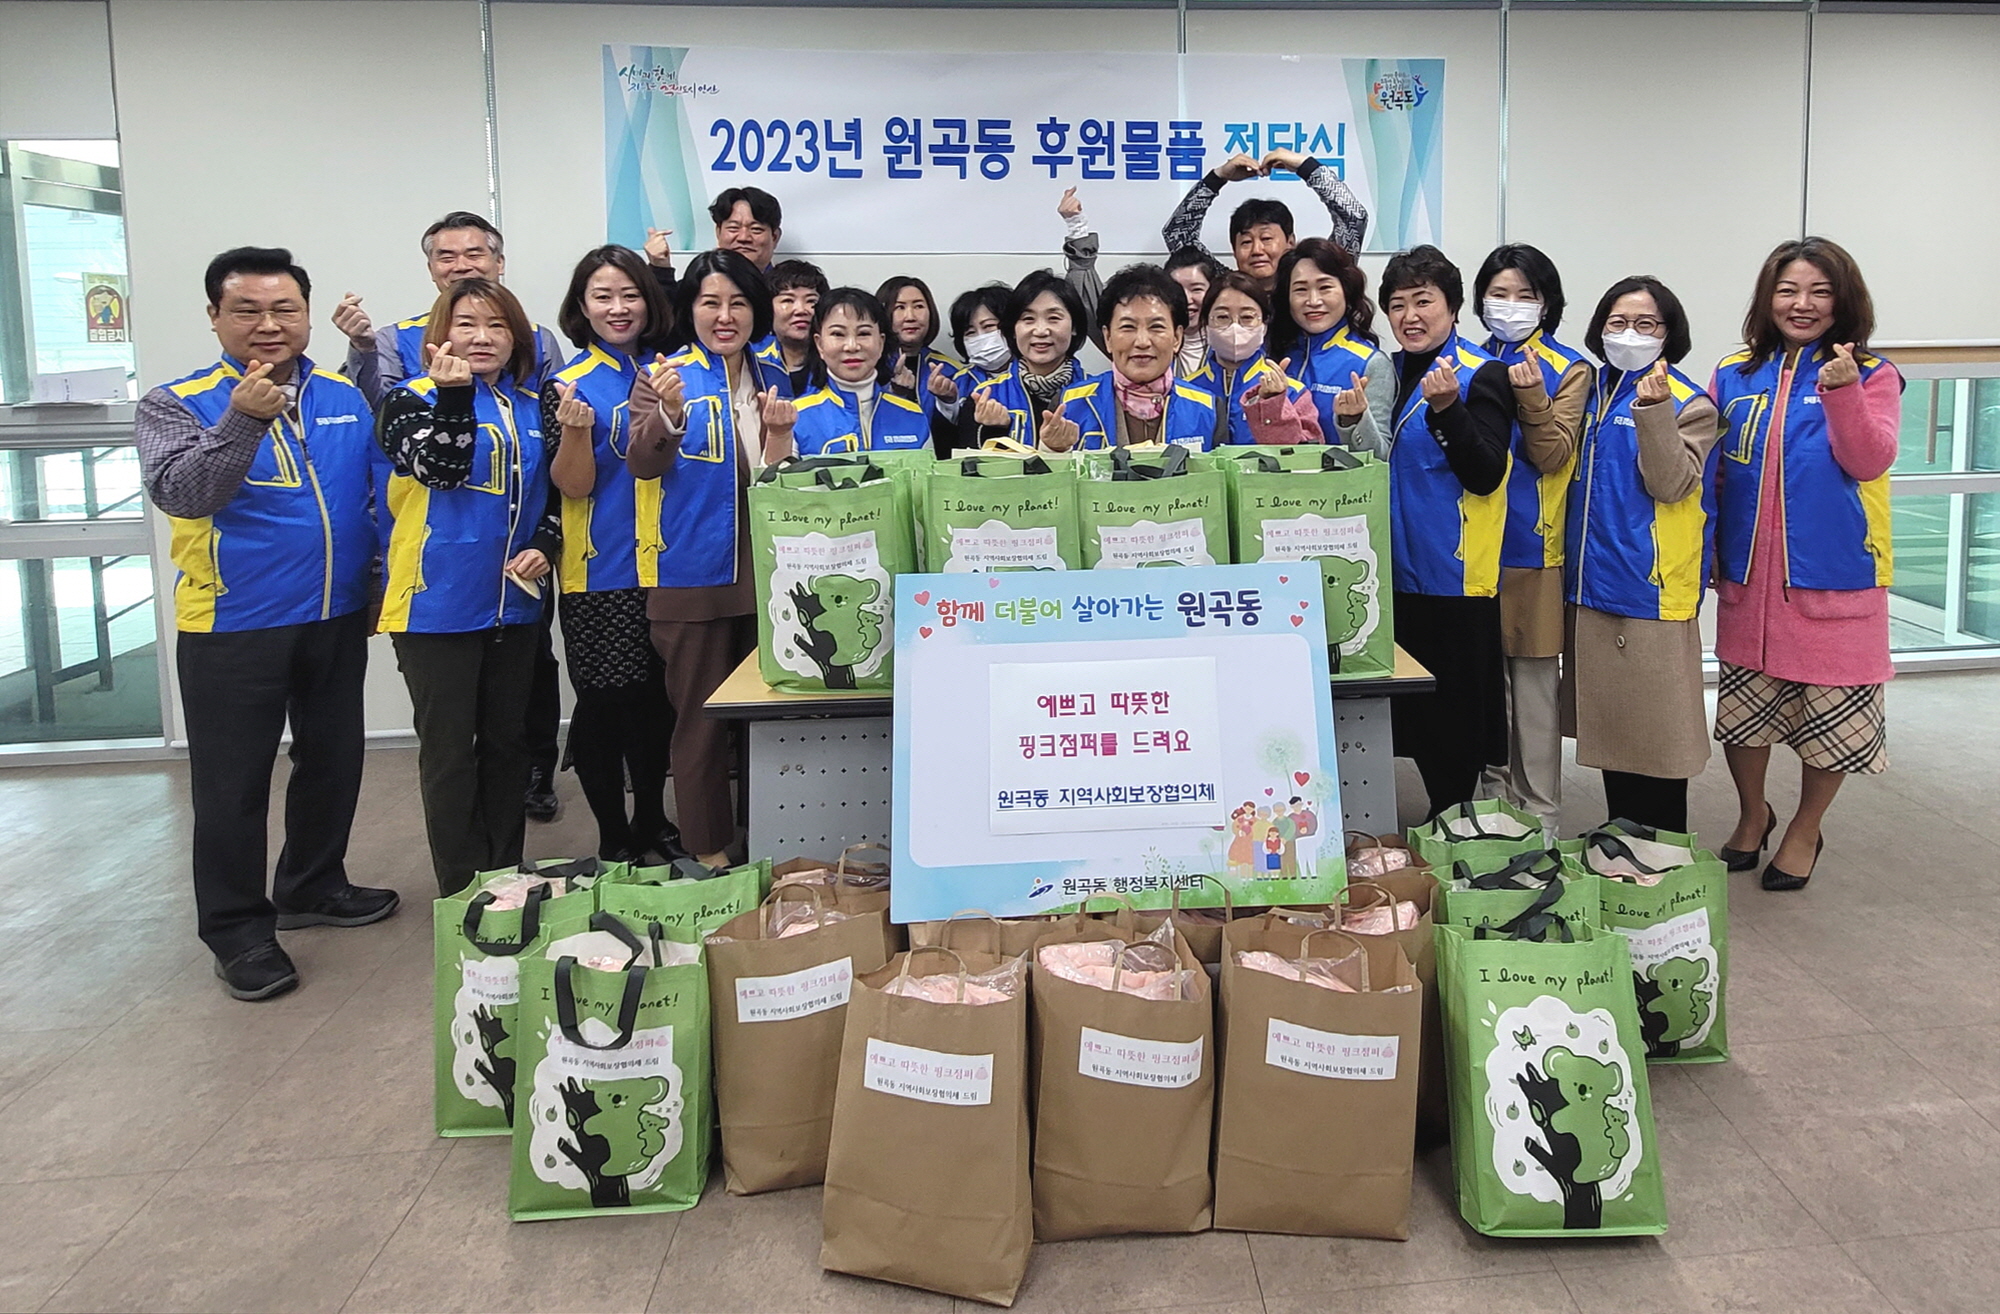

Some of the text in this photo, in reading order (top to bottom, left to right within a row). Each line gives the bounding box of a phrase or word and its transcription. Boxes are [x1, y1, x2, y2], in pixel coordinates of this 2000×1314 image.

[1380, 90, 1414, 111] 원곡동
[710, 117, 864, 179] 2023년
[883, 117, 1015, 180] 원곡동
[1032, 116, 1207, 180] 후원물품
[944, 496, 1058, 517] I love my planet!
[1093, 495, 1209, 516] I love my planet!
[1255, 490, 1372, 512] I love my planet!
[768, 508, 881, 531] I love my planet!
[936, 590, 1262, 628] 함께 더불어 살아가는 원곡동
[1037, 691, 1170, 718] 예쁘고 따뜻한
[1019, 730, 1191, 759] 핑크점퍼를 드려요
[998, 783, 1215, 808] 원곡동 지역사회보장협의체
[1062, 875, 1204, 895] 원곡동 행정복지센터
[665, 913, 685, 927] my
[693, 899, 740, 926] planet!
[1600, 900, 1609, 912] I
[1615, 903, 1651, 918] love
[1670, 885, 1706, 911] planet!
[456, 924, 463, 936] I
[1479, 967, 1613, 995] I love my planet!
[541, 987, 550, 1000] I
[594, 1001, 614, 1016] my
